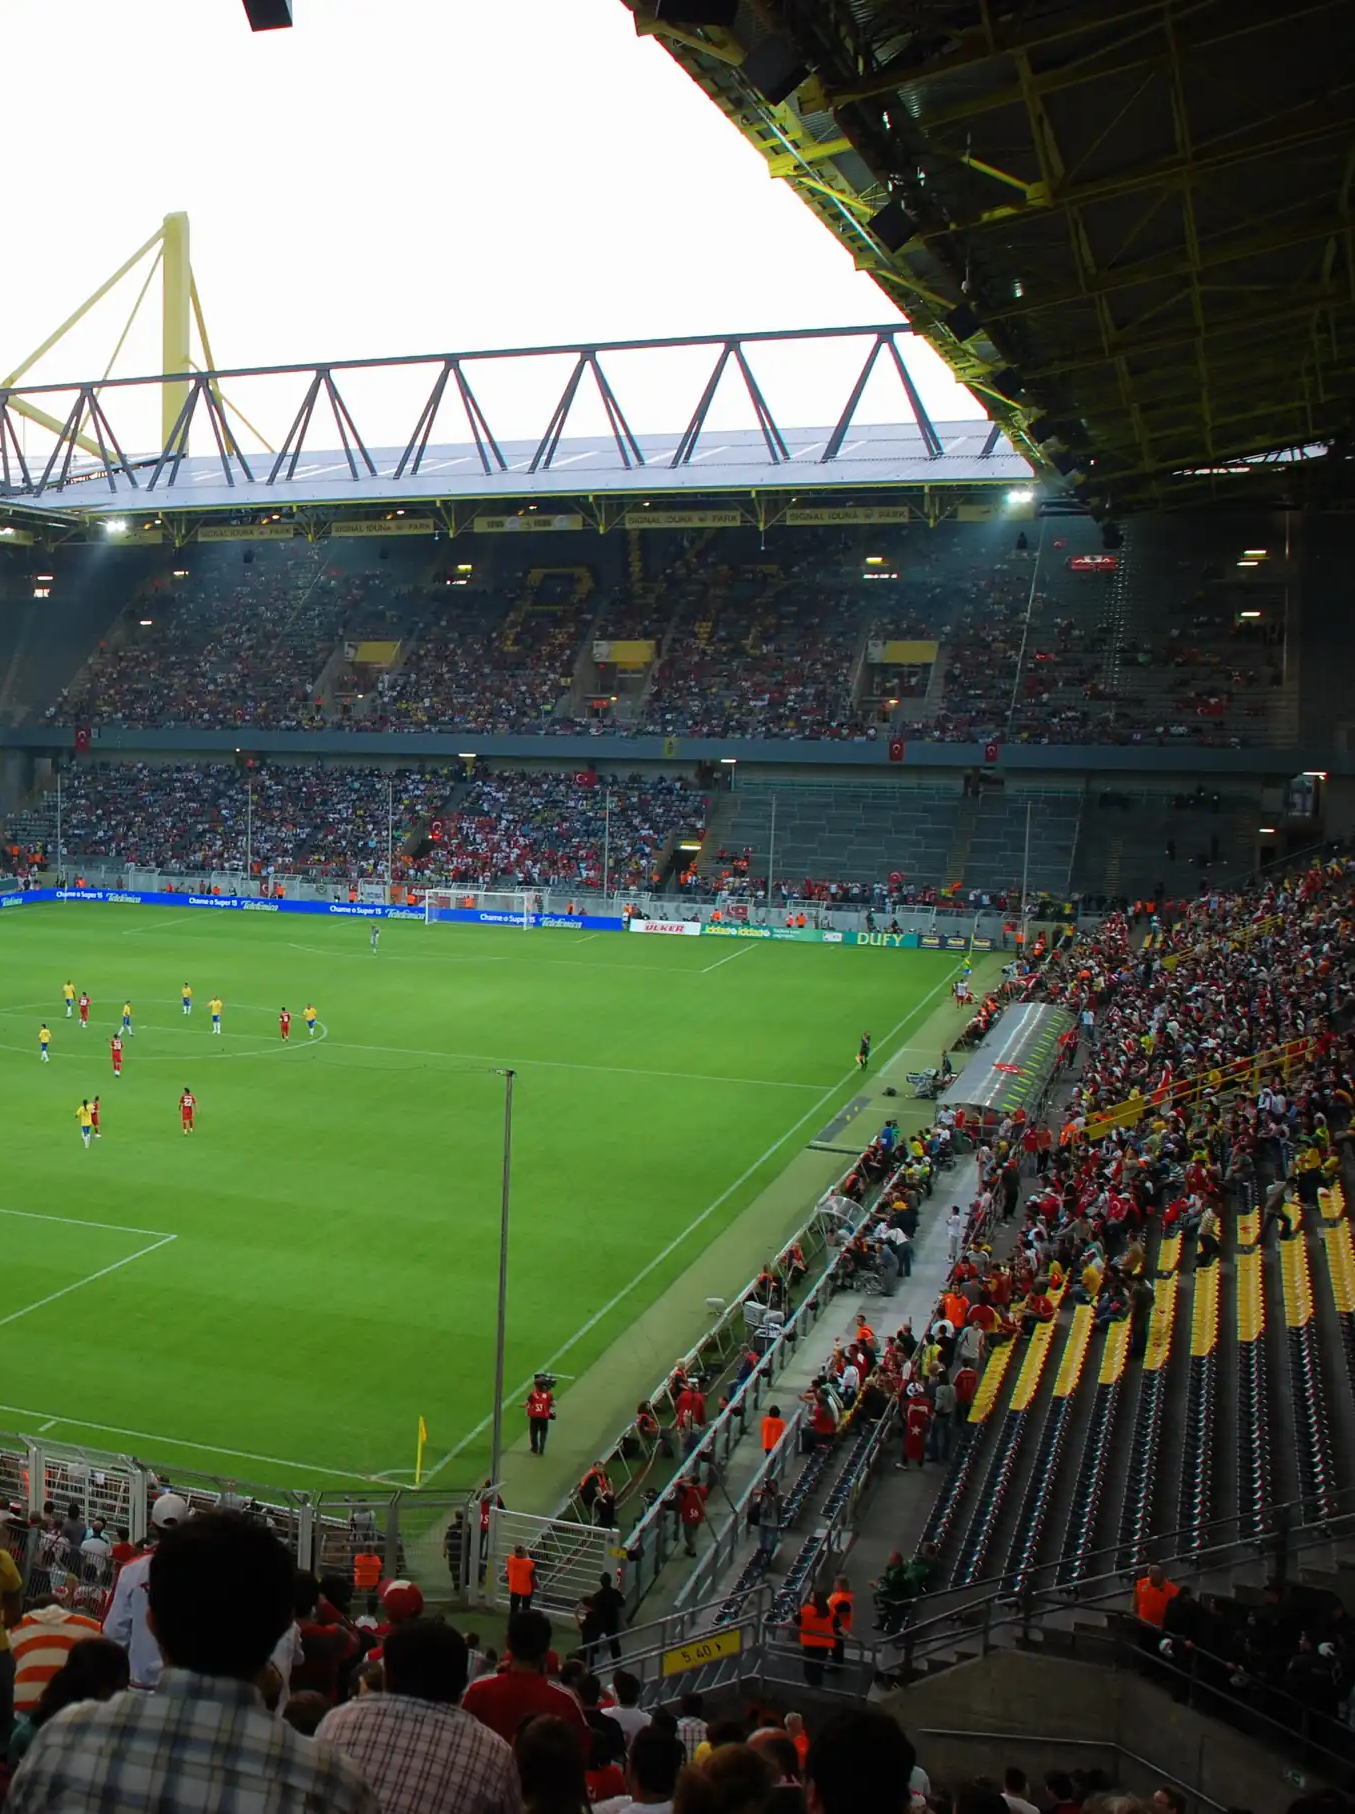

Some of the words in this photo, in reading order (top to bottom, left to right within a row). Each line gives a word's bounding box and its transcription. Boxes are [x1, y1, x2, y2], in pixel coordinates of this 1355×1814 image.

[627, 515, 662, 525] SIGNAL
[664, 515, 693, 524] IDUNA
[711, 514, 739, 523] PARK
[789, 511, 825, 521] SIGNAL
[827, 511, 859, 520] IDUNA
[878, 509, 907, 519] PARK
[270, 528, 292, 537] PARK
[408, 523, 433, 531] PARK
[329, 905, 351, 913] Chame
[357, 907, 375, 915] Super
[479, 913, 502, 921] Chame
[644, 920, 686, 933] ÜLKER
[856, 932, 905, 947] DUFY
[696, 1644, 713, 1659] 40
